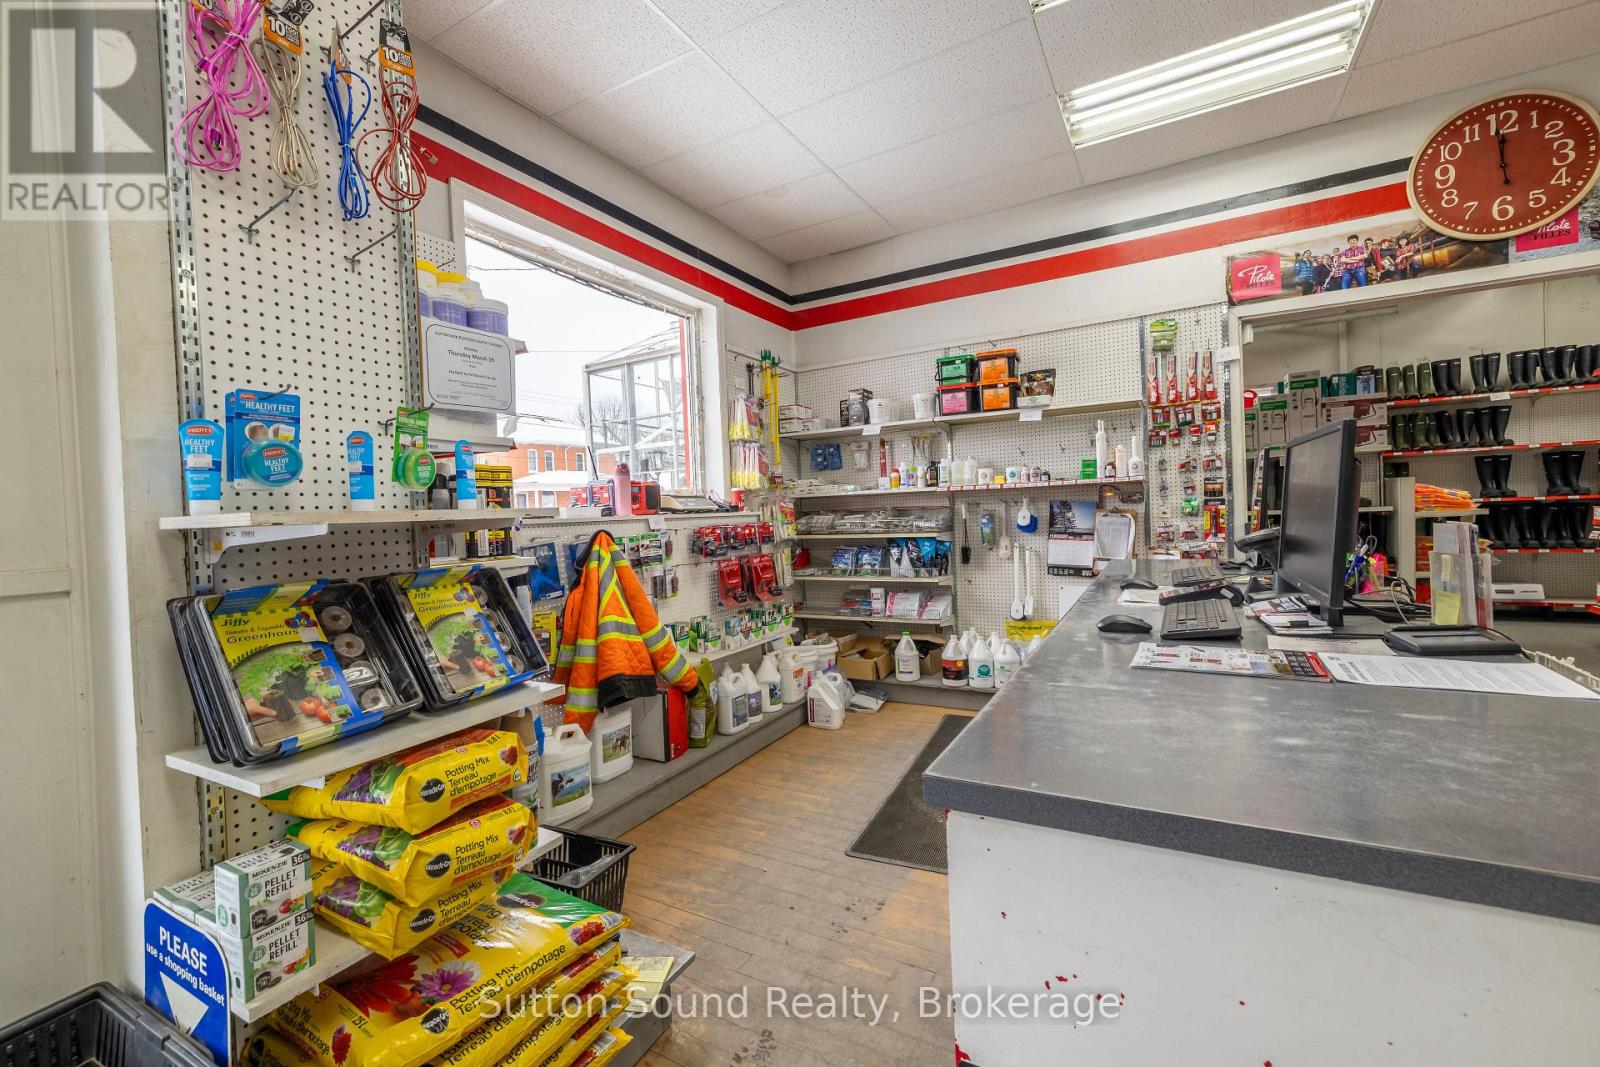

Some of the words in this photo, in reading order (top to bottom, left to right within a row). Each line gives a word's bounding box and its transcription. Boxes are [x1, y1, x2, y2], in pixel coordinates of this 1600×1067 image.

[270, 16, 286, 37] 10
[382, 46, 399, 63] 10
[1486, 109, 1519, 136] 12
[1529, 110, 1539, 129] 1
[1544, 120, 1564, 139] 2
[1462, 123, 1480, 144] 11
[1439, 142, 1463, 162] 10
[1552, 139, 1576, 166] 3
[1434, 164, 1456, 189] 9
[1550, 167, 1571, 187] 4
[1441, 188, 1459, 208] 8
[1492, 195, 1515, 221] 6
[1528, 188, 1547, 208] 5
[1463, 201, 1479, 220] 7
[1537, 218, 1571, 234] ilote
[1237, 265, 1275, 284] Pilote
[447, 349, 471, 359] Thursday
[245, 401, 277, 411] HEALTHY
[278, 404, 296, 413] FEET
[184, 438, 215, 446] HEALTHY
[264, 457, 289, 467] HEALTHY
[271, 464, 286, 473] FEET
[418, 600, 468, 612] Greenhouse
[221, 617, 250, 627] Jiffy
[226, 629, 300, 643] Greenhous
[445, 762, 475, 779] Potting
[475, 755, 490, 766] Mix
[447, 771, 479, 787] Terreau
[449, 772, 497, 797] d'empotage
[455, 840, 485, 855] Potting
[485, 834, 499, 845] Mix
[292, 853, 303, 866] 36
[454, 852, 502, 875] d'empotage
[455, 850, 486, 865] Terreau
[264, 868, 297, 889] PELLET
[468, 880, 483, 893] Mix
[265, 881, 294, 899] REFILL
[439, 898, 471, 918] Terreau
[296, 913, 306, 925] 36
[268, 928, 301, 951] PELLET
[160, 925, 207, 976] PLEASE
[269, 941, 298, 961] REFILL
[146, 942, 158, 957] use
[159, 952, 163, 962] a
[164, 955, 198, 989] shopping
[199, 977, 225, 1007] basket
[455, 982, 503, 1015] Terreau
[505, 944, 566, 987] d'empotage
[450, 978, 497, 1007] Potting
[495, 964, 518, 979] Mix
[445, 1031, 493, 1067] Terreau
